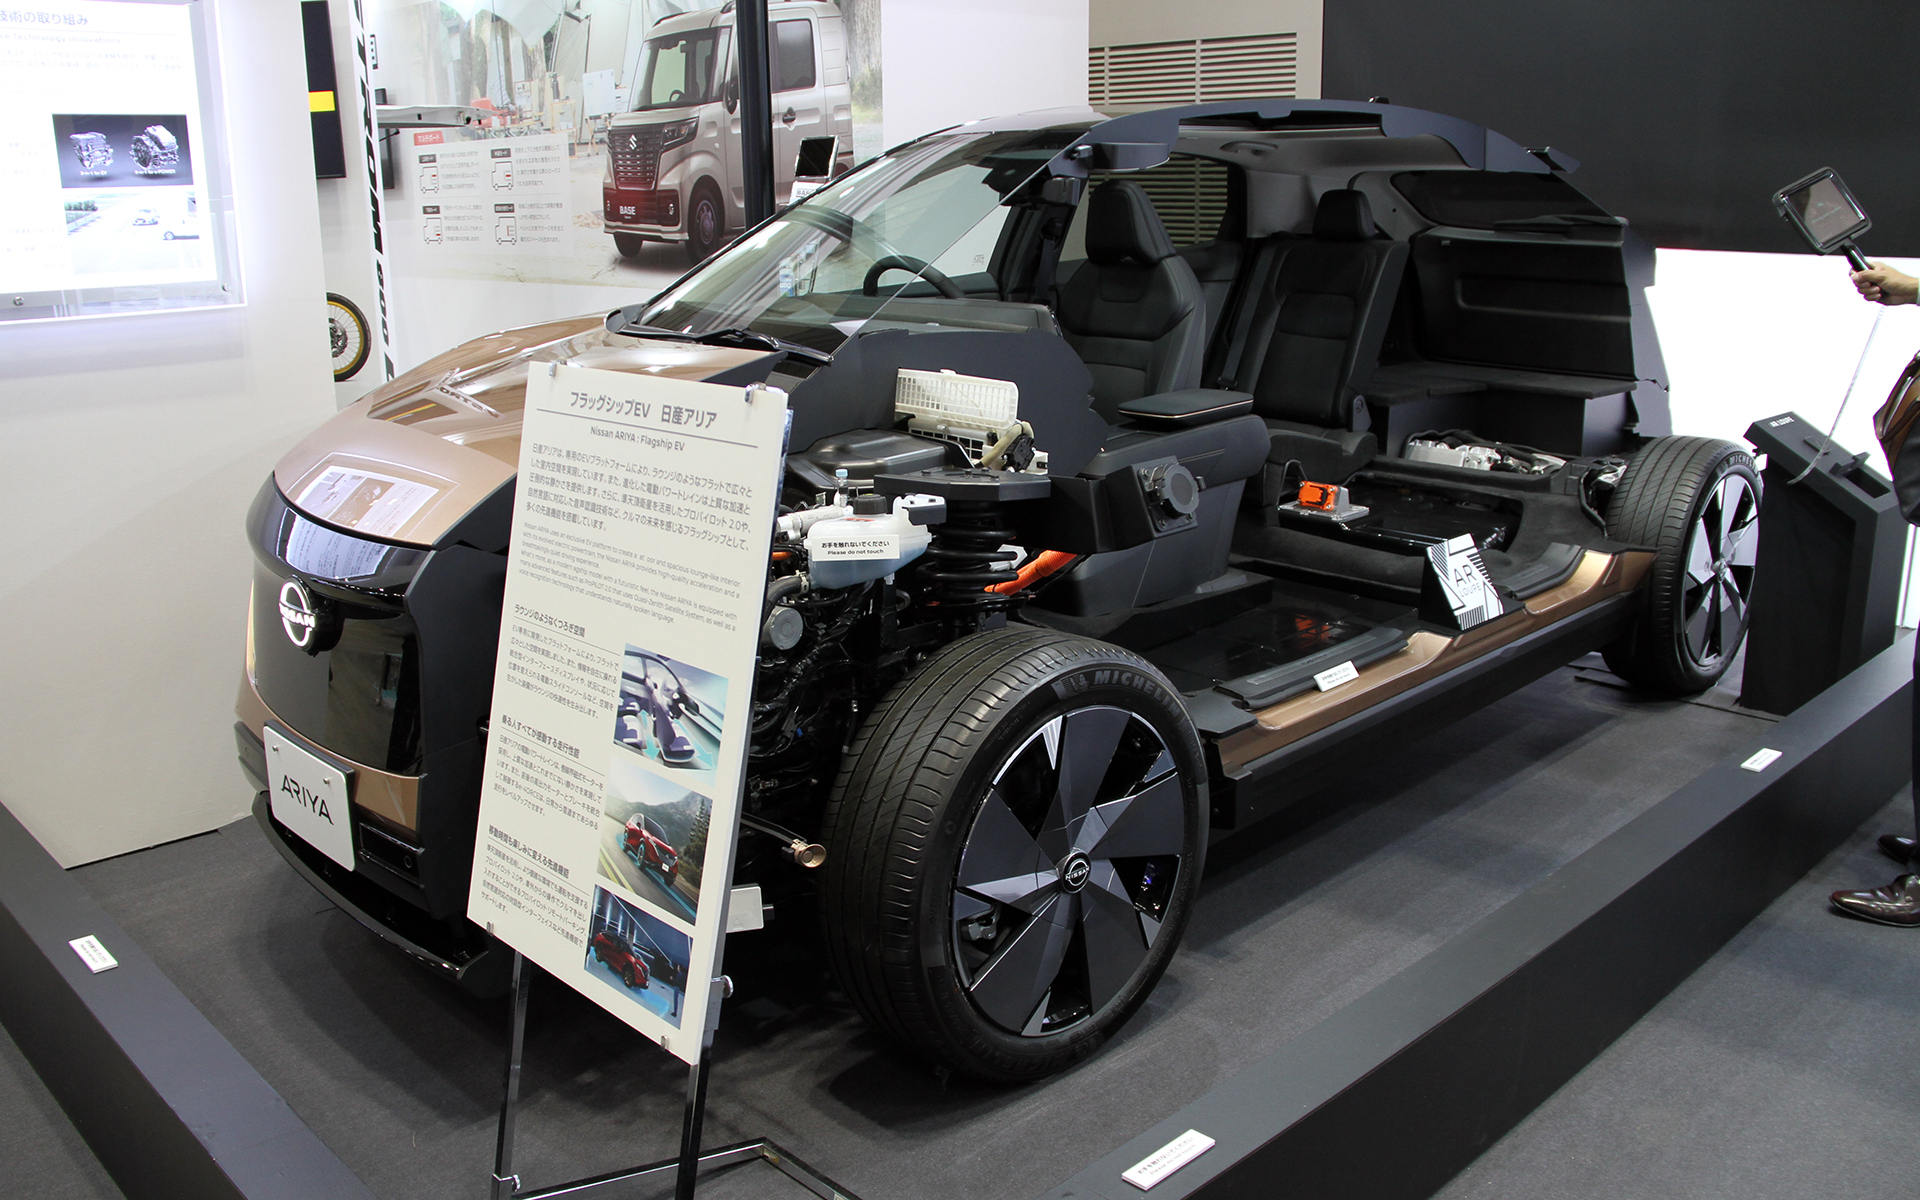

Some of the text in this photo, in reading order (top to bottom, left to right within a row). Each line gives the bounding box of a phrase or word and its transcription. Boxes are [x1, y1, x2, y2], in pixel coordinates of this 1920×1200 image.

[13, 33, 66, 43] Technology
[69, 36, 121, 44] Innovations
[619, 205, 636, 215] BASE
[570, 391, 717, 429] フラッグシップEV 日産アリア
[590, 425, 613, 438] Nissan
[614, 430, 635, 442] ARIYA
[640, 434, 672, 449] Flagship
[674, 440, 685, 451] EV
[521, 540, 549, 554] breathtakingly
[561, 552, 575, 562] driving
[524, 522, 537, 530] Nissan
[537, 525, 549, 533] ARIYA
[565, 534, 585, 544] exclusive
[592, 541, 611, 550] platform
[618, 548, 633, 557] create
[666, 562, 689, 573] spacious
[821, 540, 890, 549] お手を触れないでください
[538, 536, 554, 545] evolved
[554, 541, 570, 549] electric
[596, 552, 604, 560] the
[605, 554, 621, 563] Nissan
[621, 559, 635, 568] ARIYA
[635, 564, 657, 575] provides
[658, 569, 688, 585] high-quality
[689, 579, 723, 593] acceleration
[723, 589, 735, 597] and
[1453, 564, 1477, 587] AR
[520, 559, 530, 567] many
[531, 563, 550, 573] advanced
[550, 568, 567, 578] features
[612, 587, 622, 595] that
[633, 593, 663, 608] Quasi-Zenith
[664, 603, 684, 615] Satellite
[712, 619, 723, 627] well
[529, 571, 551, 582] recognition
[551, 578, 574, 591] technology
[575, 586, 584, 594] that
[585, 590, 612, 603] understands
[613, 598, 632, 610] naturally
[633, 605, 650, 614] spoken
[556, 560, 572, 569] modern
[588, 570, 602, 579] model
[618, 578, 639, 590] futuristic
[659, 591, 676, 601] Nissan
[677, 596, 692, 606] ARIYA
[698, 604, 723, 616] equipped
[724, 612, 737, 620] with
[1458, 582, 1482, 598] LOUPE
[278, 602, 315, 628] NISSAN
[514, 603, 585, 638] ラウンジのようなくつろぎ空間
[1093, 670, 1181, 718] MICHELIN
[501, 714, 580, 759] 乗る人すべてが感動する走行性能
[280, 774, 334, 826] ARIYA
[488, 824, 569, 879] 移動時間も楽しみに変える先進機能
[1065, 865, 1089, 881] NISSAN
